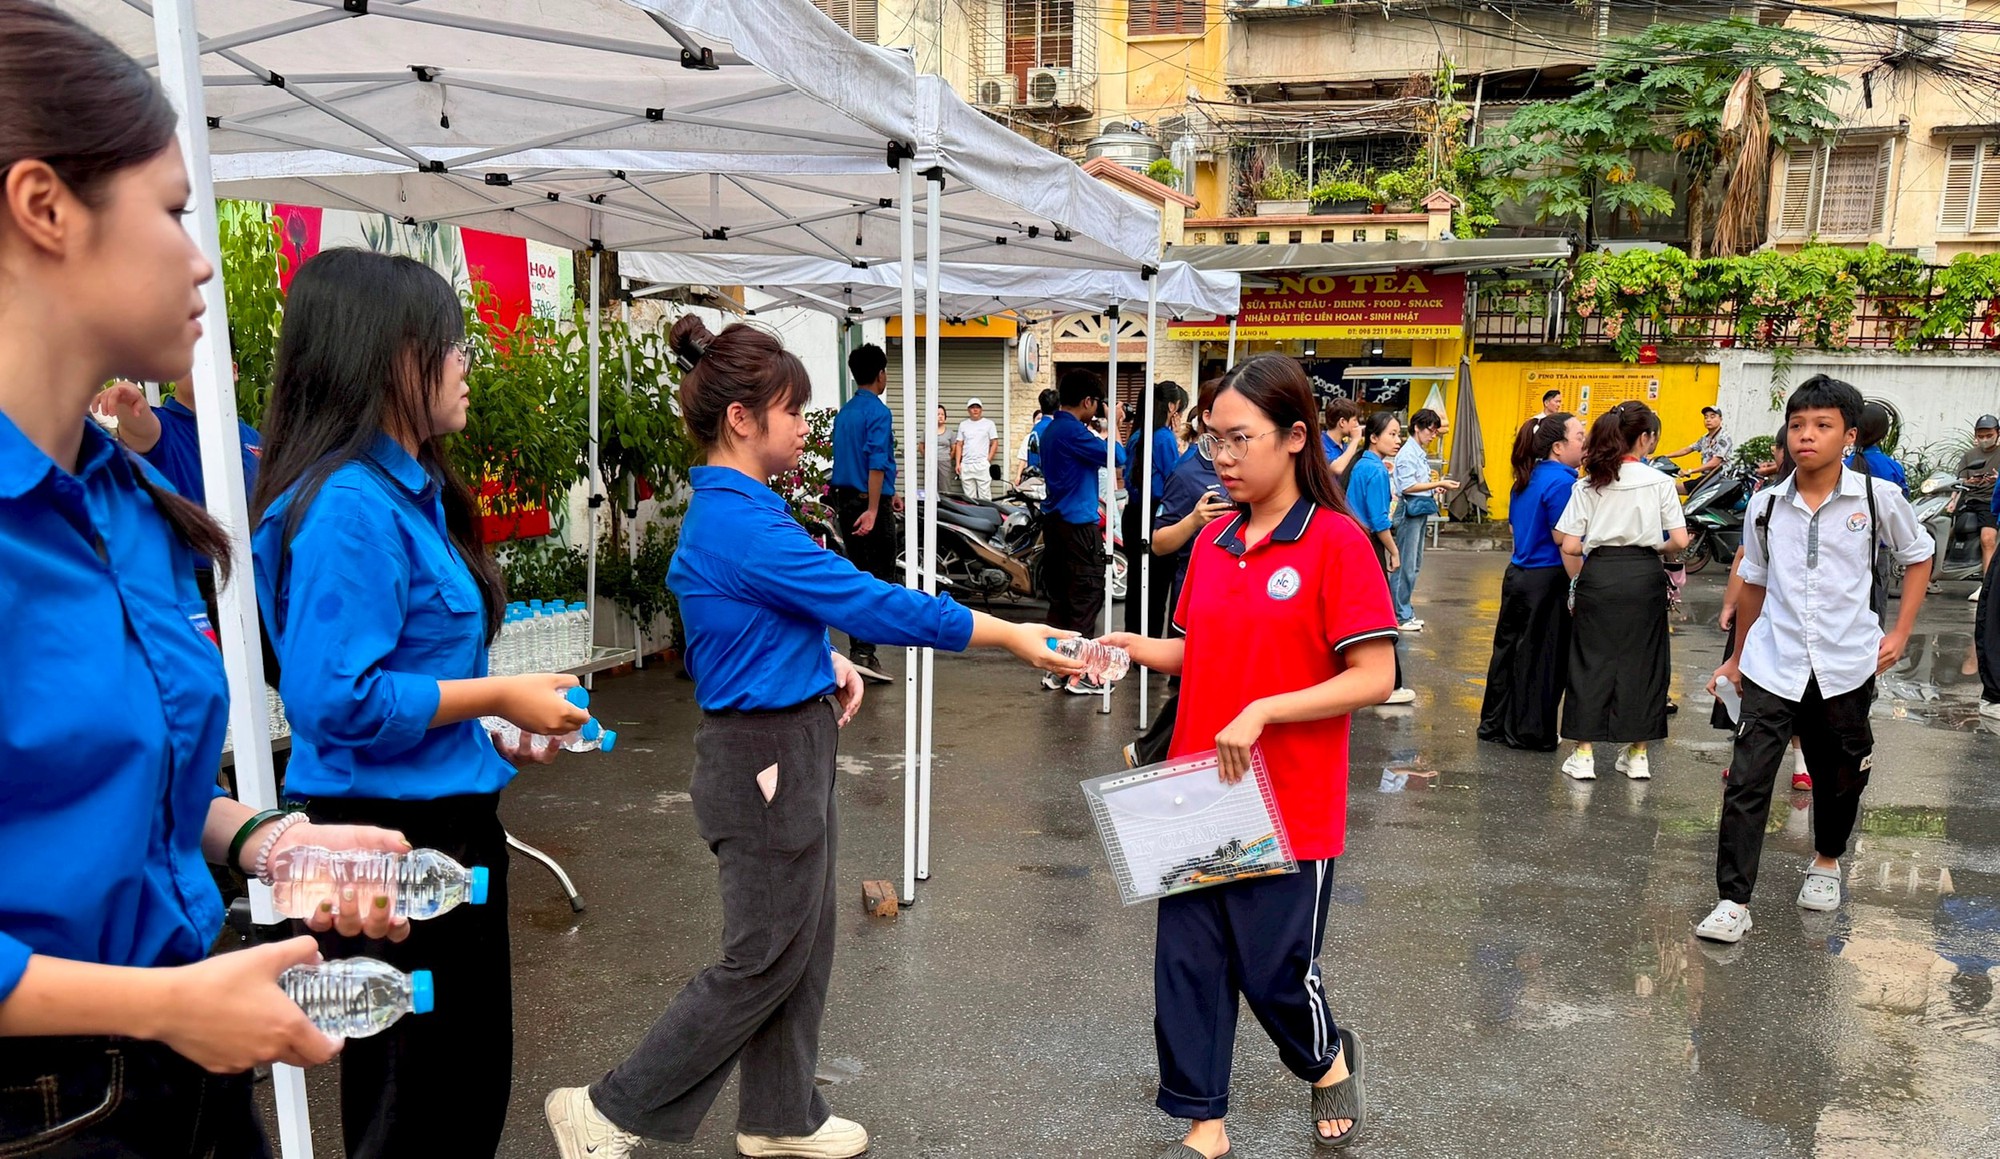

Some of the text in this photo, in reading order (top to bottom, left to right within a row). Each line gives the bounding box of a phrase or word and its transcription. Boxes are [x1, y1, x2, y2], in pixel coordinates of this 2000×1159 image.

[1347, 274, 1429, 294] TEA
[1247, 300, 1266, 309] SỮA
[1298, 299, 1326, 309] CHÂU
[1333, 299, 1366, 309] DRINK
[1373, 299, 1401, 308] FOOD
[1408, 299, 1443, 308] SNACK
[1245, 313, 1270, 324] NHẬN
[1293, 313, 1312, 323] TIỆC
[1314, 312, 1333, 321] LIÊN
[1335, 313, 1363, 321] HOAN
[1369, 312, 1392, 321] SINH
[1393, 311, 1419, 322] NHẬT
[1435, 327, 1451, 335] 3131
[1158, 824, 1221, 849] CLEAR
